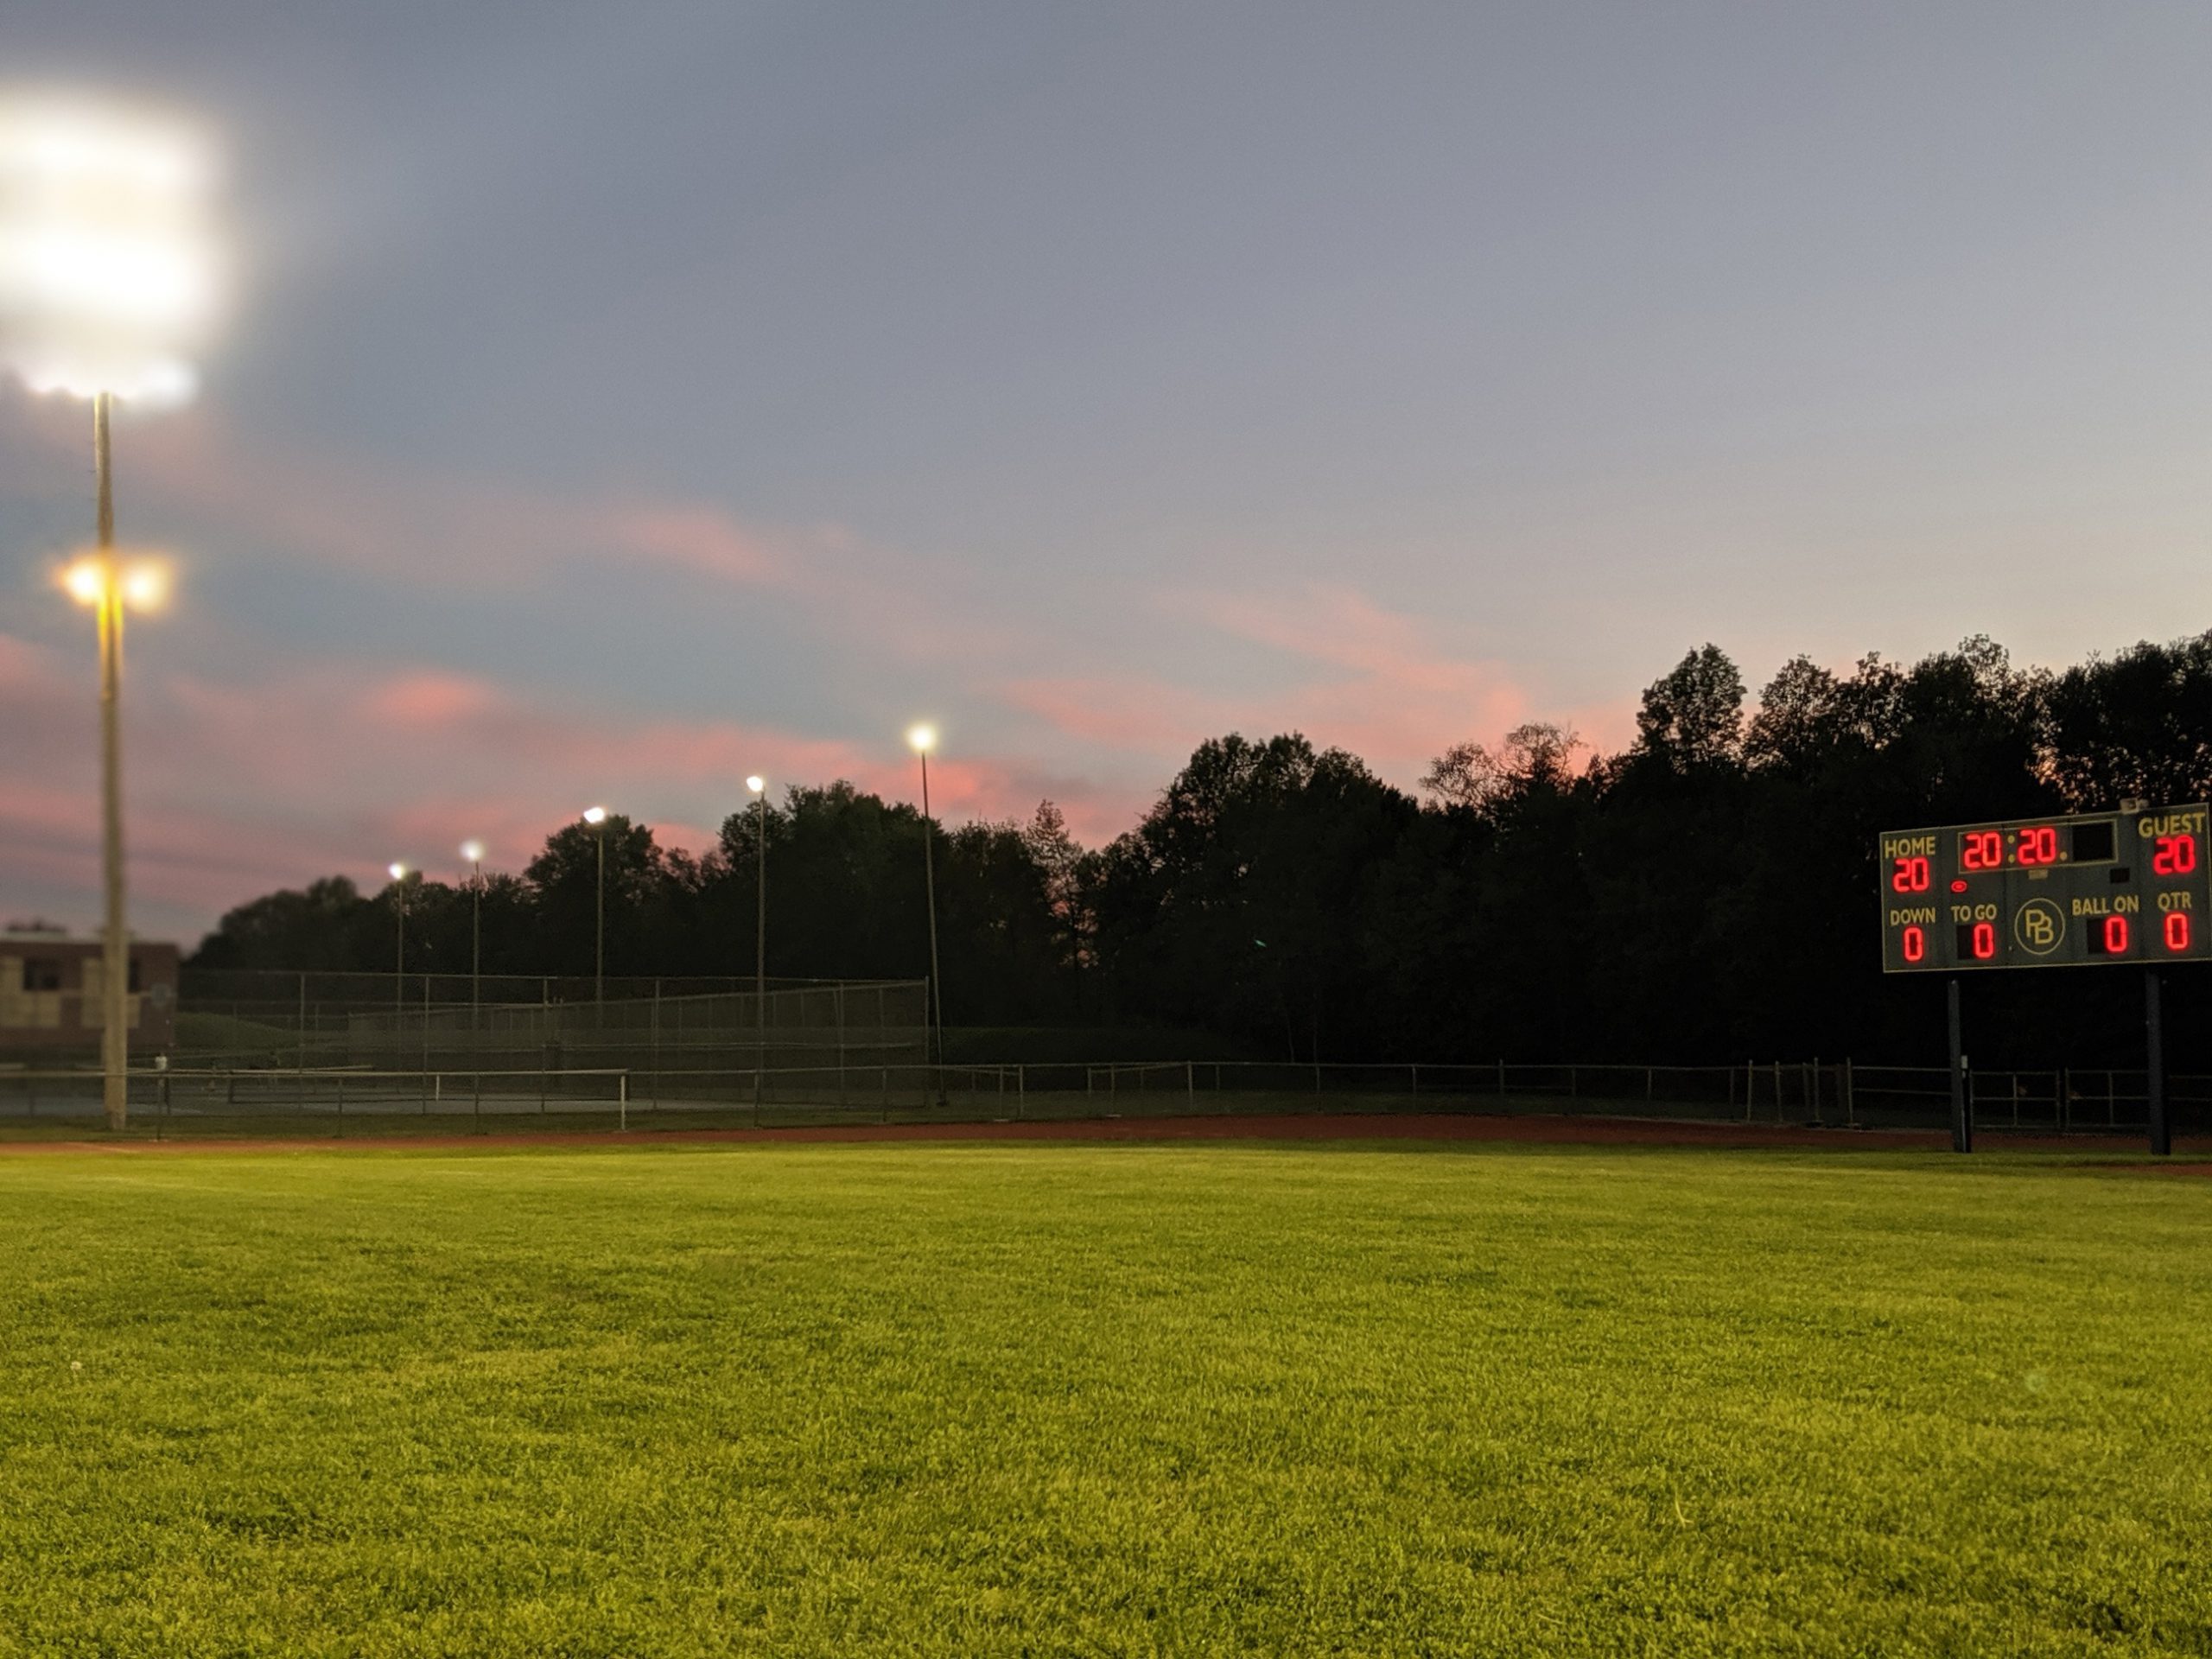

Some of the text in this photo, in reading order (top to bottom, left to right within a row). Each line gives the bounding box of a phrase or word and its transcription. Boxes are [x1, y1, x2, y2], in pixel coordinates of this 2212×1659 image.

[2139, 812, 2206, 838] GUEST
[1885, 836, 1936, 858] HOME
[2152, 835, 2196, 875] 20
[1892, 856, 1929, 893] 20
[1890, 907, 1936, 926] DOWN
[1951, 905, 1998, 922] TO GO
[2072, 895, 2139, 916] BALL ON
[2158, 891, 2192, 911] QTR
[1904, 926, 1923, 962] 0
[1974, 923, 1994, 959] 0
[2105, 916, 2128, 952] 0
[2165, 912, 2189, 950] 0
